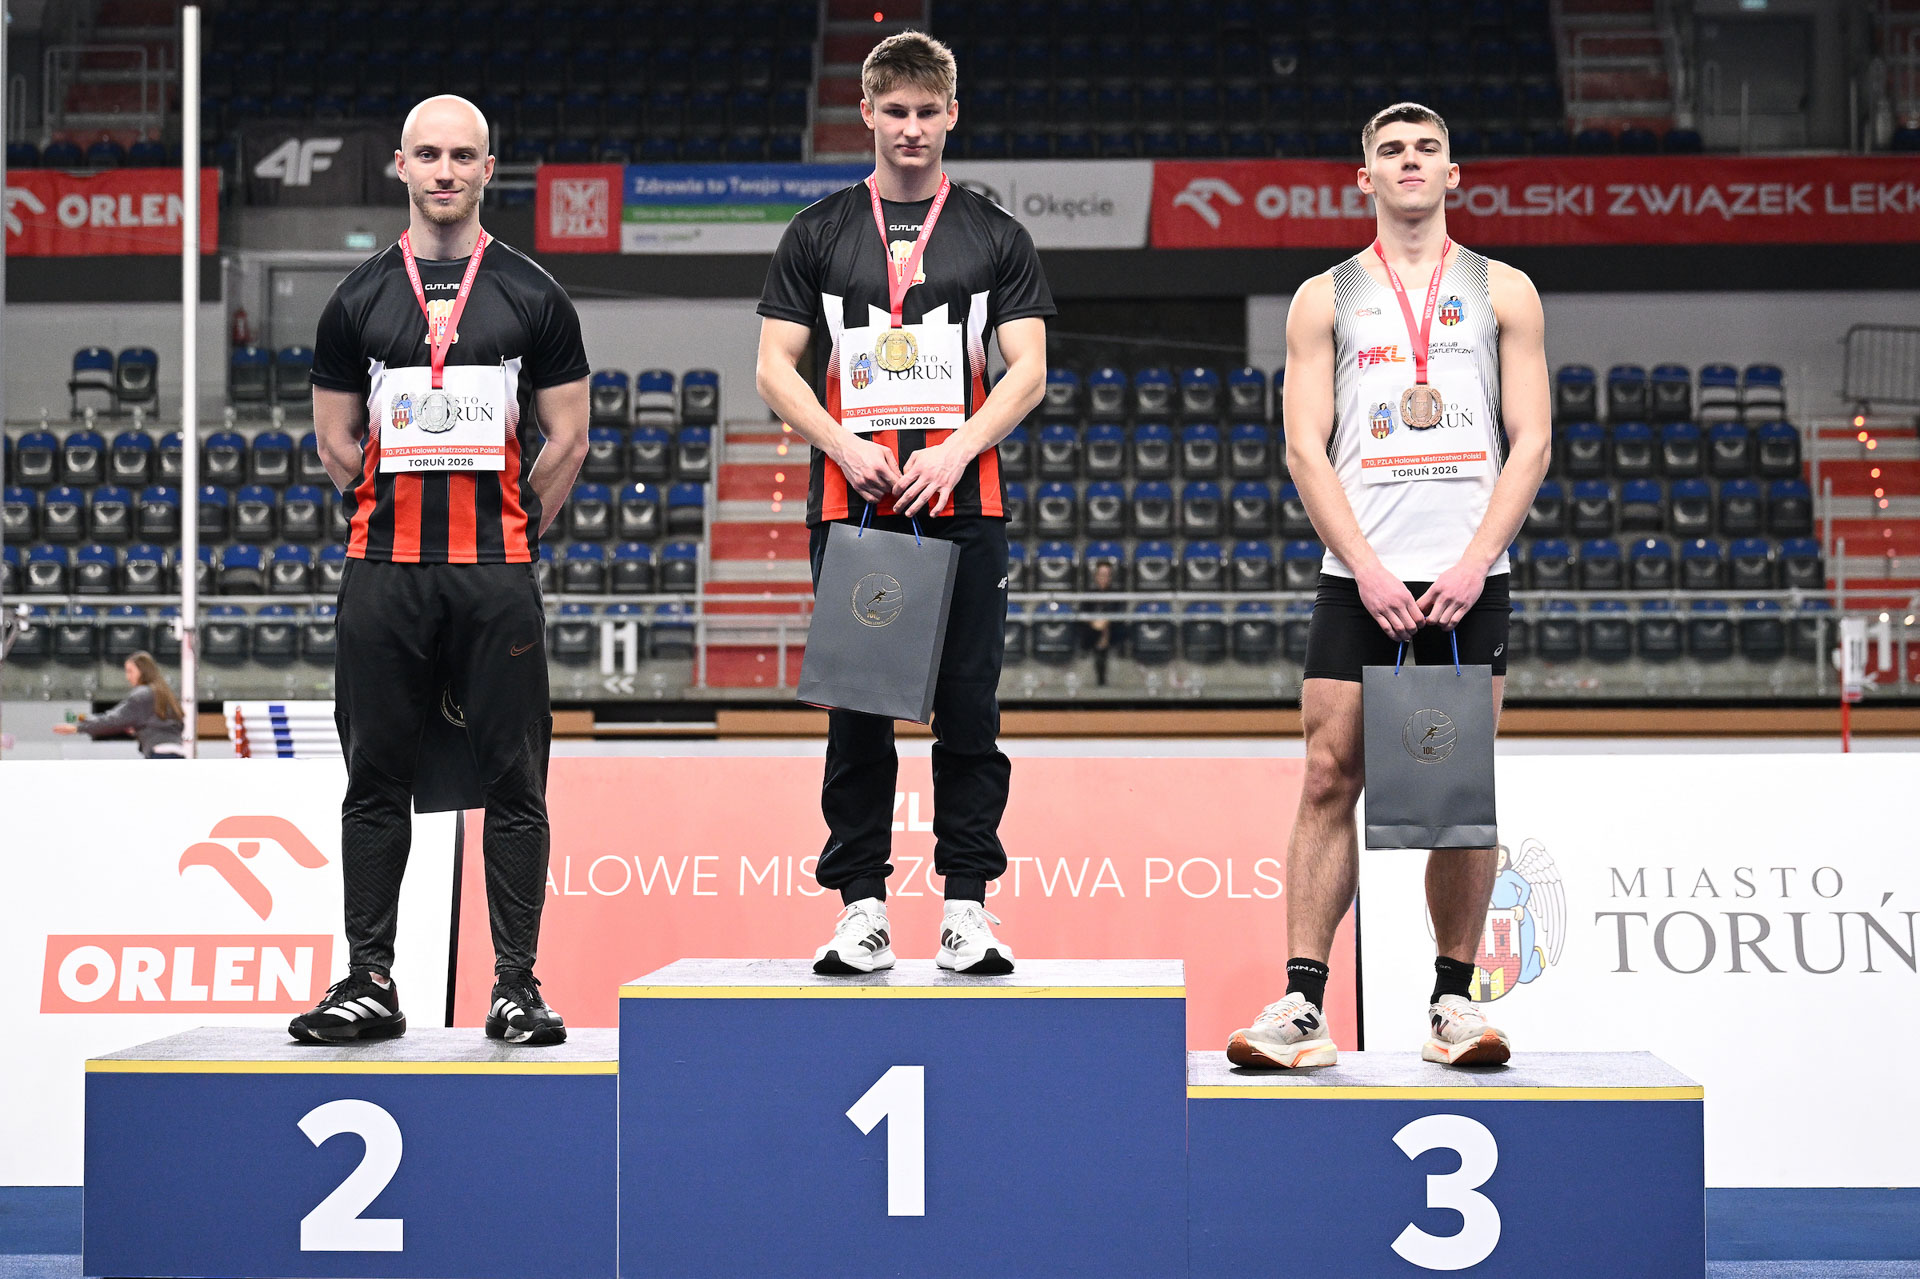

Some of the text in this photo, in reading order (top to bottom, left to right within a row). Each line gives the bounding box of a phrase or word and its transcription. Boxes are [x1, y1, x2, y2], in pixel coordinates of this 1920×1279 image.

[254, 138, 343, 186] 4F
[1022, 193, 1115, 221] Okęcie
[1446, 184, 1594, 216] POLSKI
[1605, 183, 1813, 221] ZWIĄZEK
[1358, 345, 1406, 368] MKL
[456, 402, 494, 421] RUŃ
[870, 415, 936, 427] TORUŃ 2026
[899, 405, 939, 413] Mistrzostwa
[408, 456, 474, 467] TORUŃ 2026
[438, 446, 480, 454] Mistrzostwa
[1421, 454, 1462, 462] Mistrzostwa
[1391, 465, 1458, 477] TORUŃ 2026
[546, 855, 719, 897] LOWE
[1145, 857, 1283, 899] POLS
[1608, 866, 1844, 898] MIASTO
[1594, 891, 1920, 974] TORUŃ
[58, 945, 314, 1003] ORLEN
[845, 1065, 925, 1217] 1
[297, 1098, 404, 1252] 2
[1390, 1113, 1502, 1271] 3
